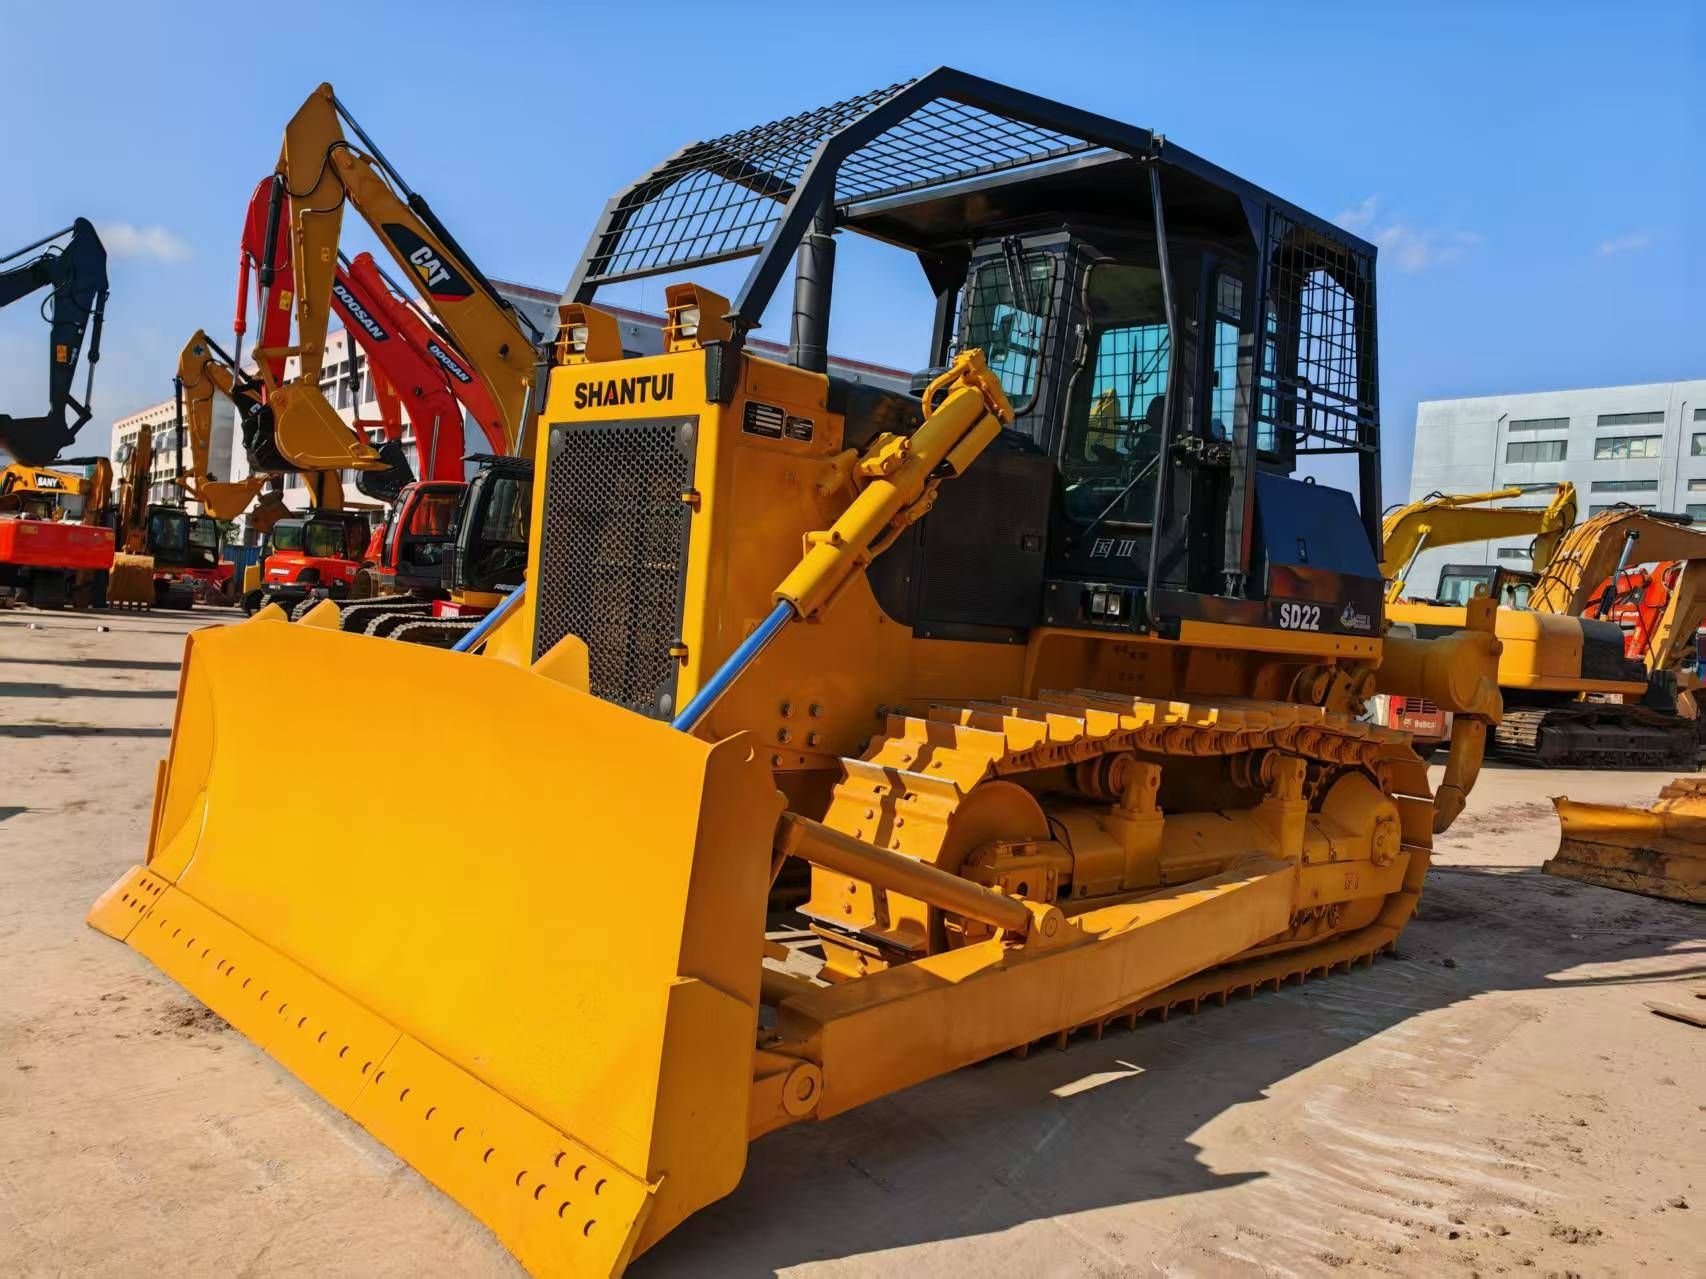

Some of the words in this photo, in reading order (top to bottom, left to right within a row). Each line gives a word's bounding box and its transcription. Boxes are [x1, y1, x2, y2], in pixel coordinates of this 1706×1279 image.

[409, 246, 450, 287] CAT
[333, 285, 384, 338] DOOSAN
[429, 345, 469, 381] DOOSAN
[574, 373, 675, 410] SHANTUI
[37, 476, 57, 488] SANY
[1280, 603, 1320, 630] SD22
